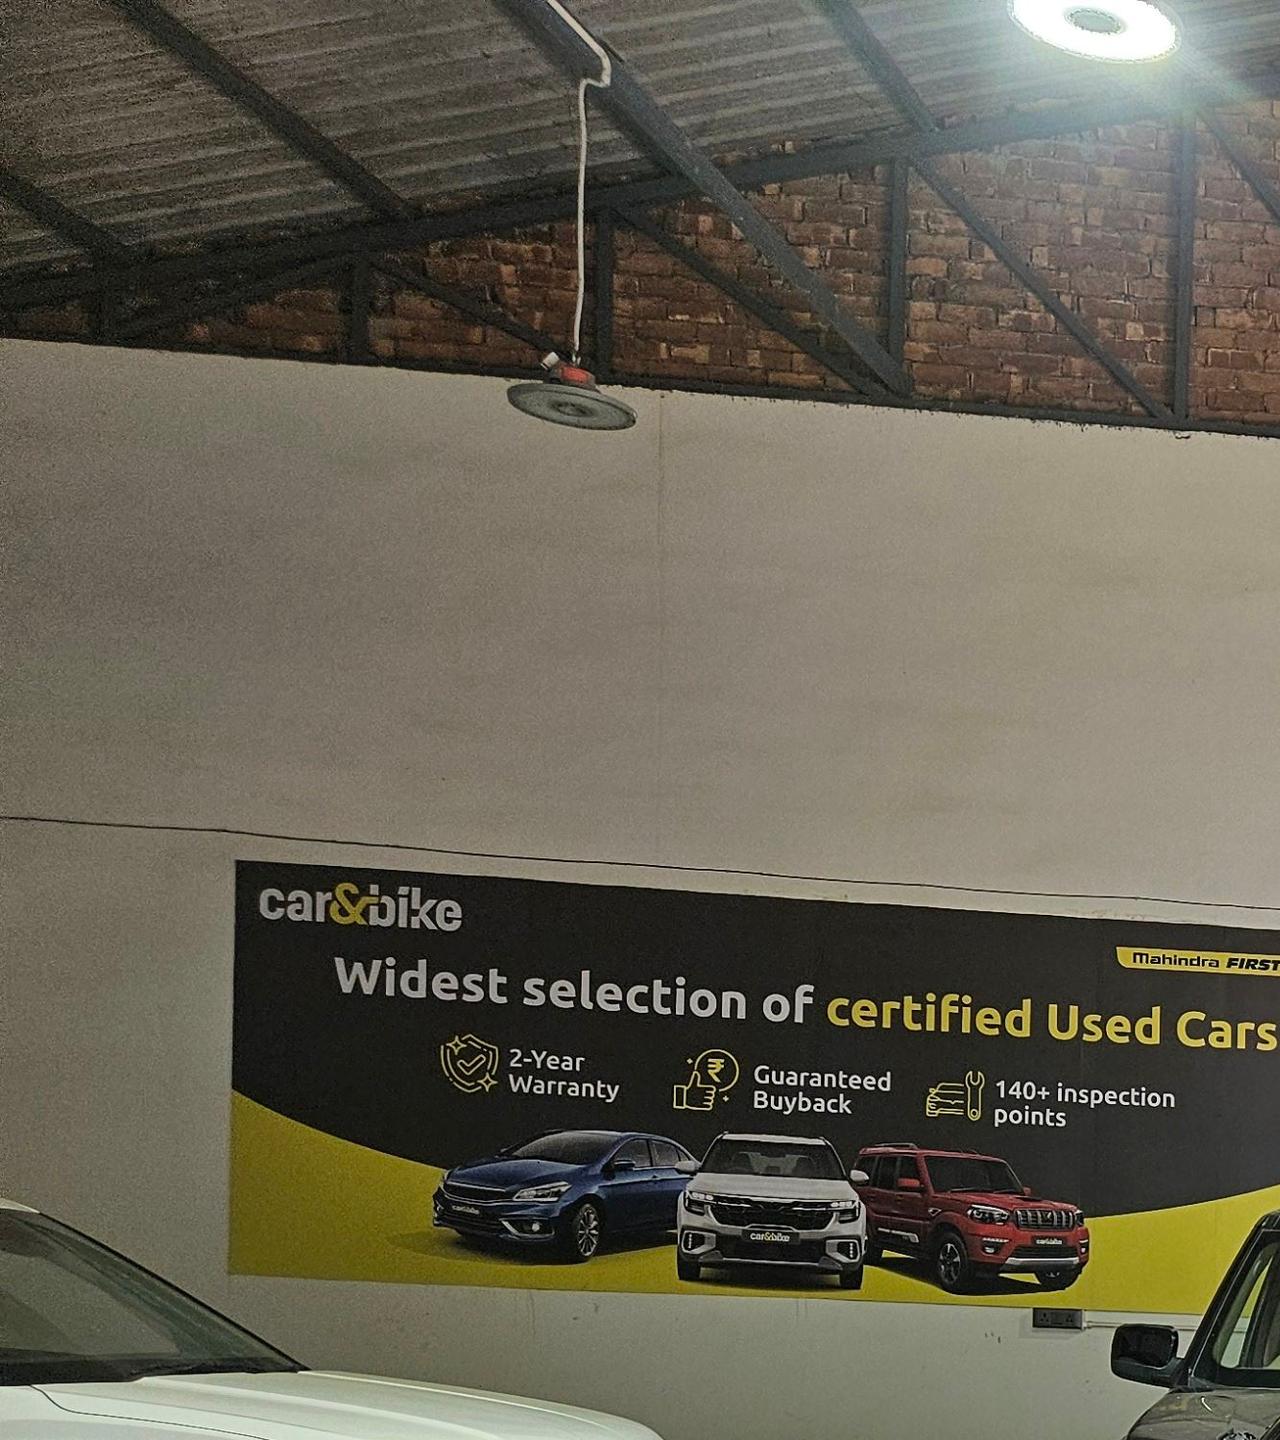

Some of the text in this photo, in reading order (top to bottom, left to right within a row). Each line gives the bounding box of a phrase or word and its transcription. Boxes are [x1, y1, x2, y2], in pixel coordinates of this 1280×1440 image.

[258, 882, 463, 932] car&bike
[1132, 951, 1220, 969] Mahindra
[334, 956, 1279, 1051] Widest selection of certified Used Cars
[508, 1048, 585, 1073] 2-Year
[508, 1073, 620, 1103] Warranty
[754, 1065, 893, 1092] Guaranteed
[753, 1090, 853, 1120] Buyback
[995, 1079, 1176, 1109] 140+ inspection
[993, 1105, 1067, 1129] points
